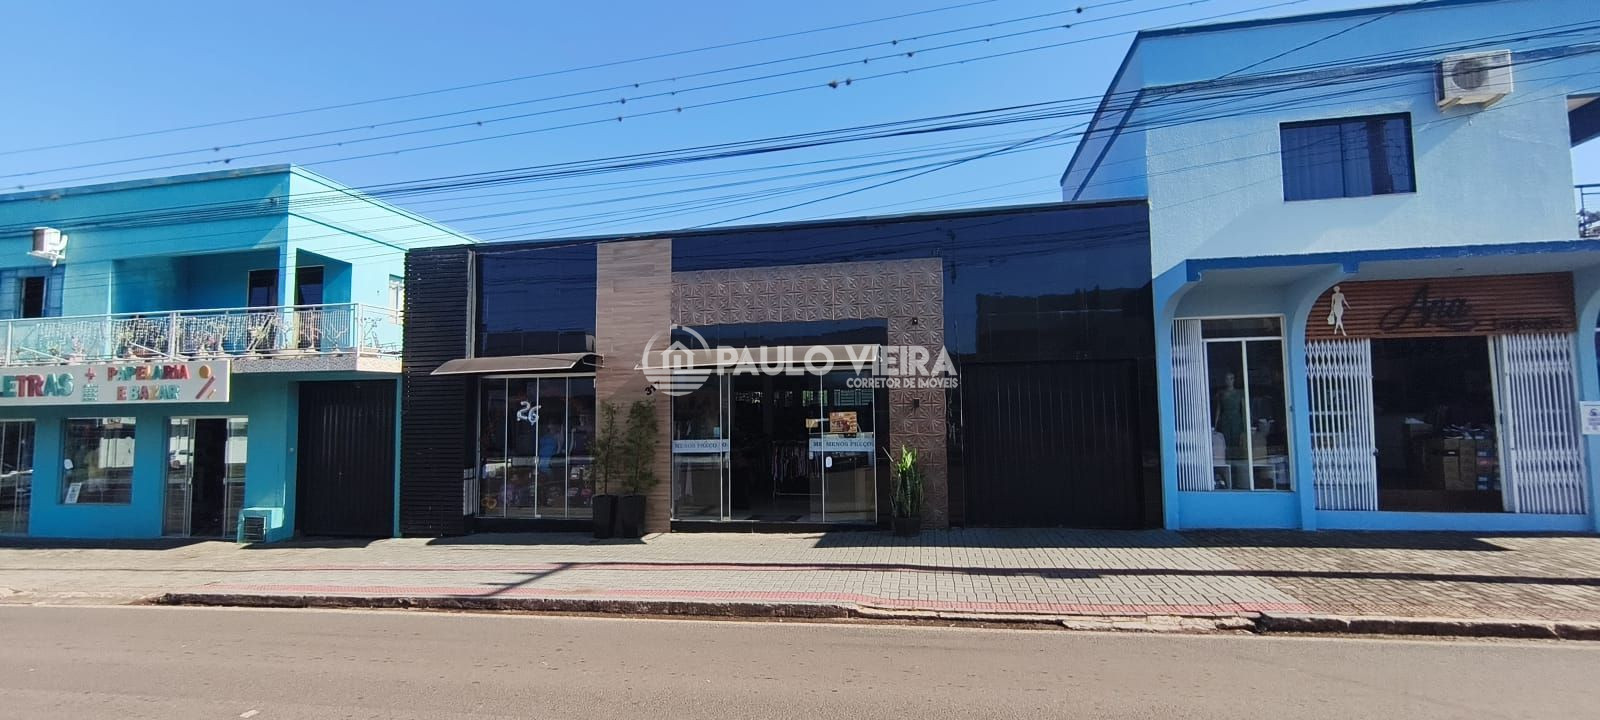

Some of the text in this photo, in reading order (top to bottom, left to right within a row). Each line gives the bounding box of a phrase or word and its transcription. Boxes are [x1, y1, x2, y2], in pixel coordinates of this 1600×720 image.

[107, 364, 191, 382] PAPELARIA
[0, 373, 74, 398] ETRAS
[116, 384, 181, 401] E BAZAR
